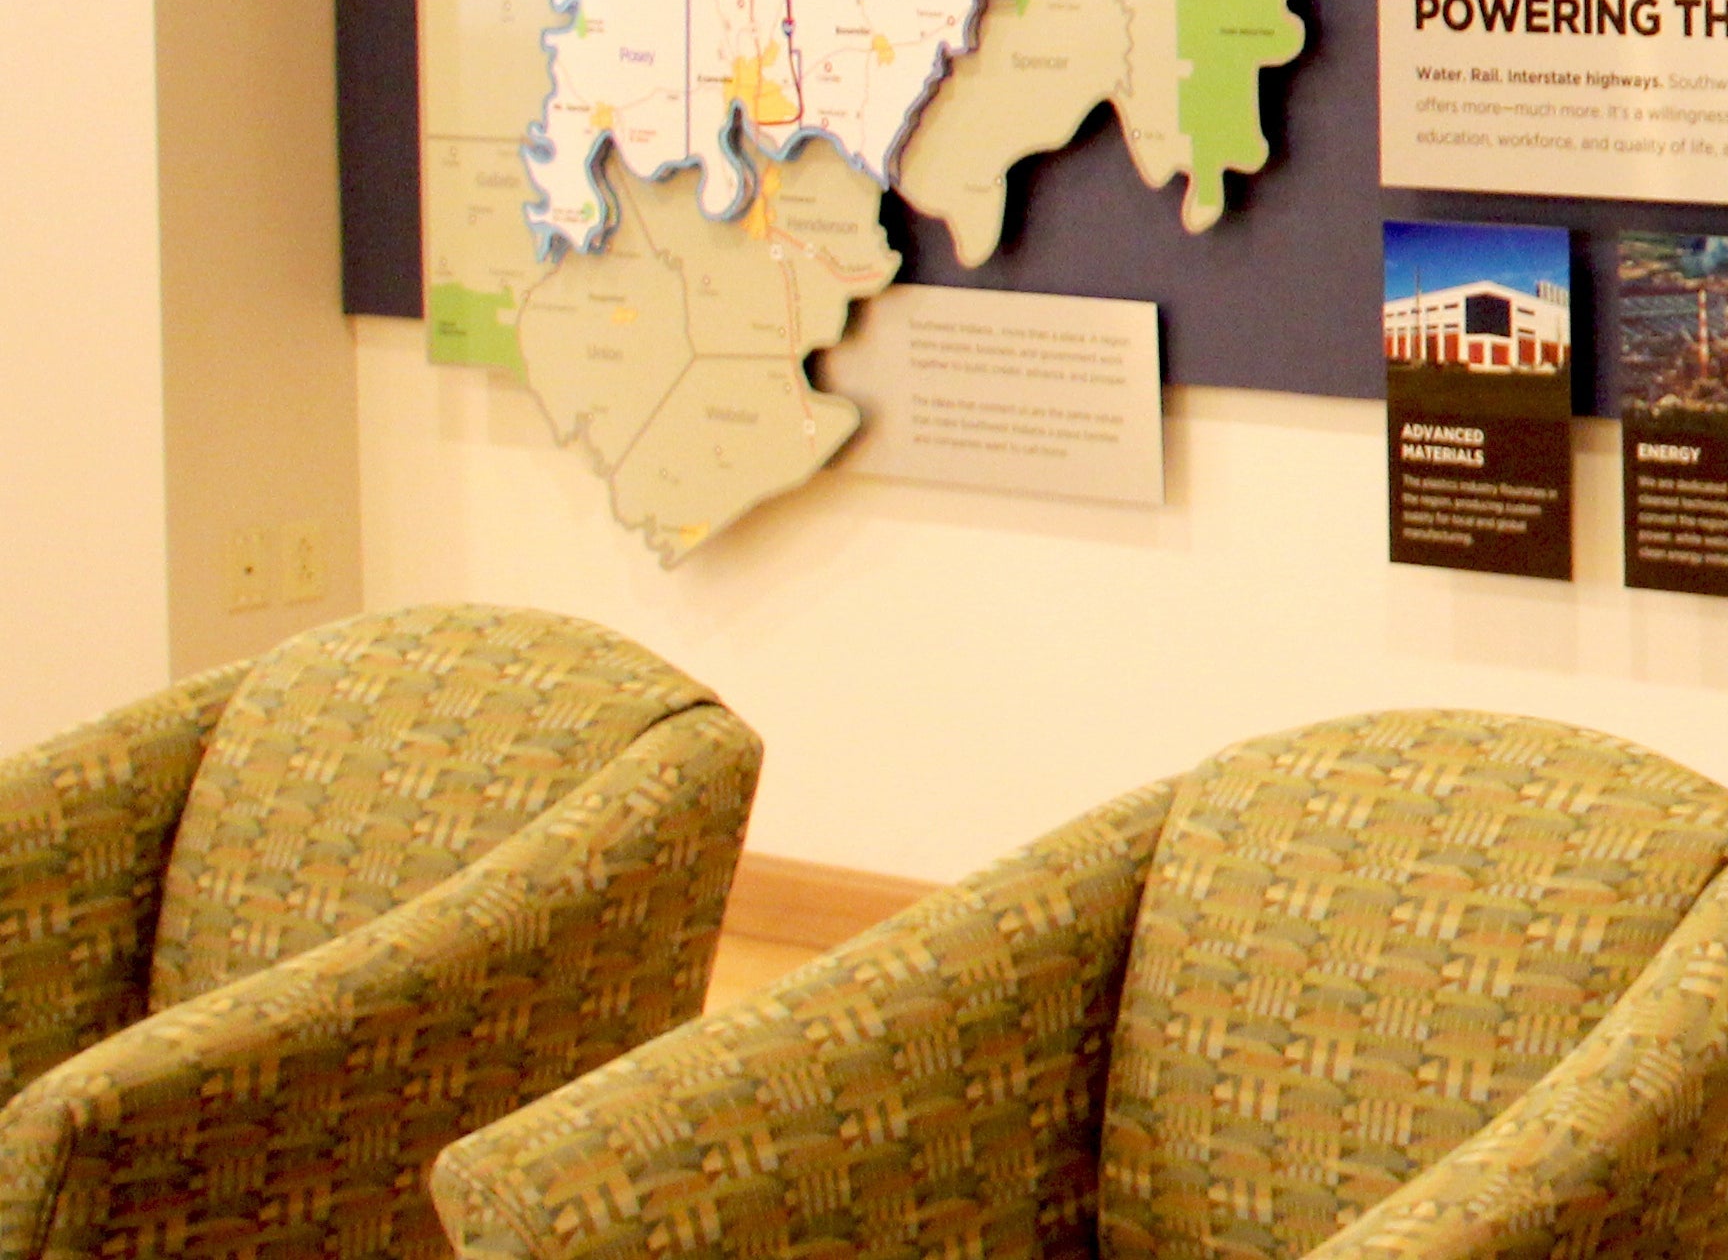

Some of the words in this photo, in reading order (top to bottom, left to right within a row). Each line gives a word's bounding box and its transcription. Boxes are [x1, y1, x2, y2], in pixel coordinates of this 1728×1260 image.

[1507, 68, 1582, 86] Interstate
[1415, 96, 1460, 114] offers
[1633, 108, 1644, 120] a
[1580, 136, 1610, 151] and
[1612, 139, 1666, 155] quality
[1669, 137, 1687, 154] of
[1401, 423, 1484, 444] ADVANCED
[1401, 443, 1485, 467] MATERIALS
[1636, 442, 1701, 463] ENERGY
